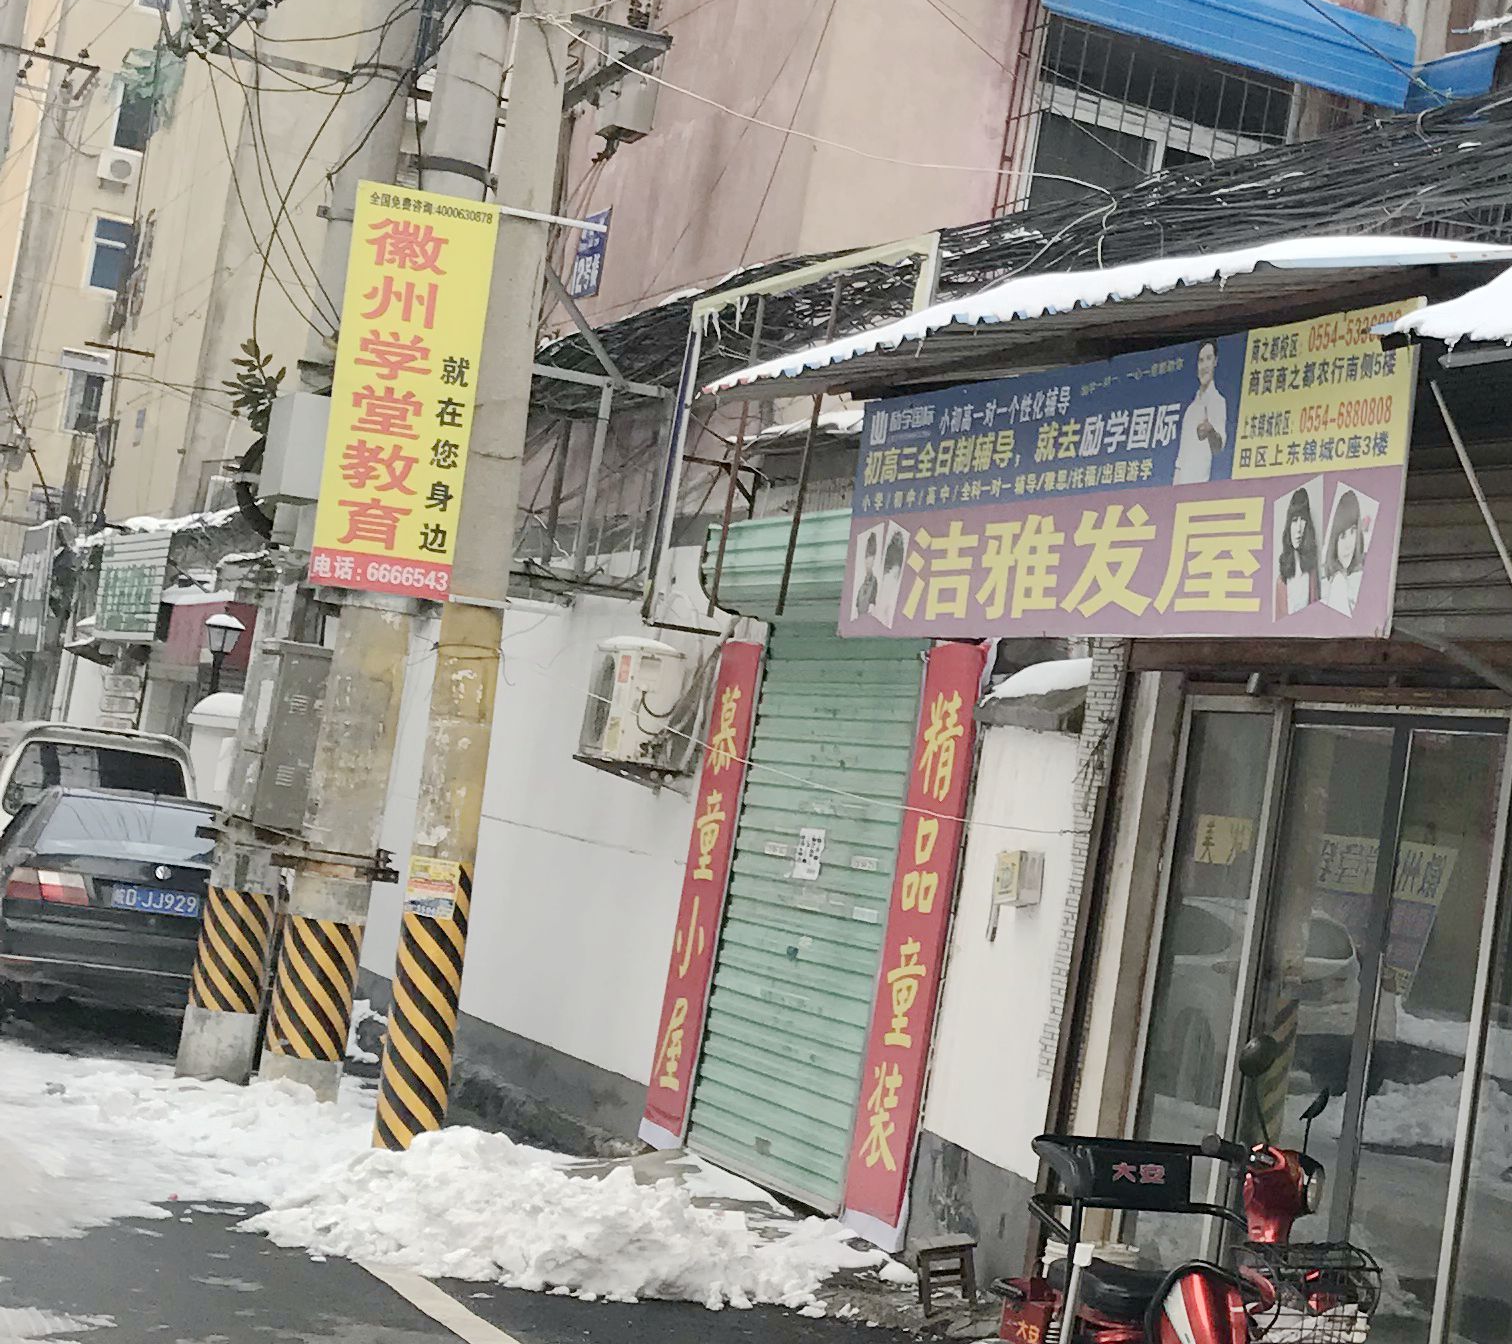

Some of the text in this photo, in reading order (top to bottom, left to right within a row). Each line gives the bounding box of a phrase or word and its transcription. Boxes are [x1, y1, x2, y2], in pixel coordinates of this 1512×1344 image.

[336, 217, 449, 551] 徽州学堂教育
[419, 356, 471, 554] 就在您身边
[1299, 395, 1393, 434] 0554-6880808
[902, 496, 1265, 621] 洁雅发屋
[860, 691, 963, 1173] 精品童装
